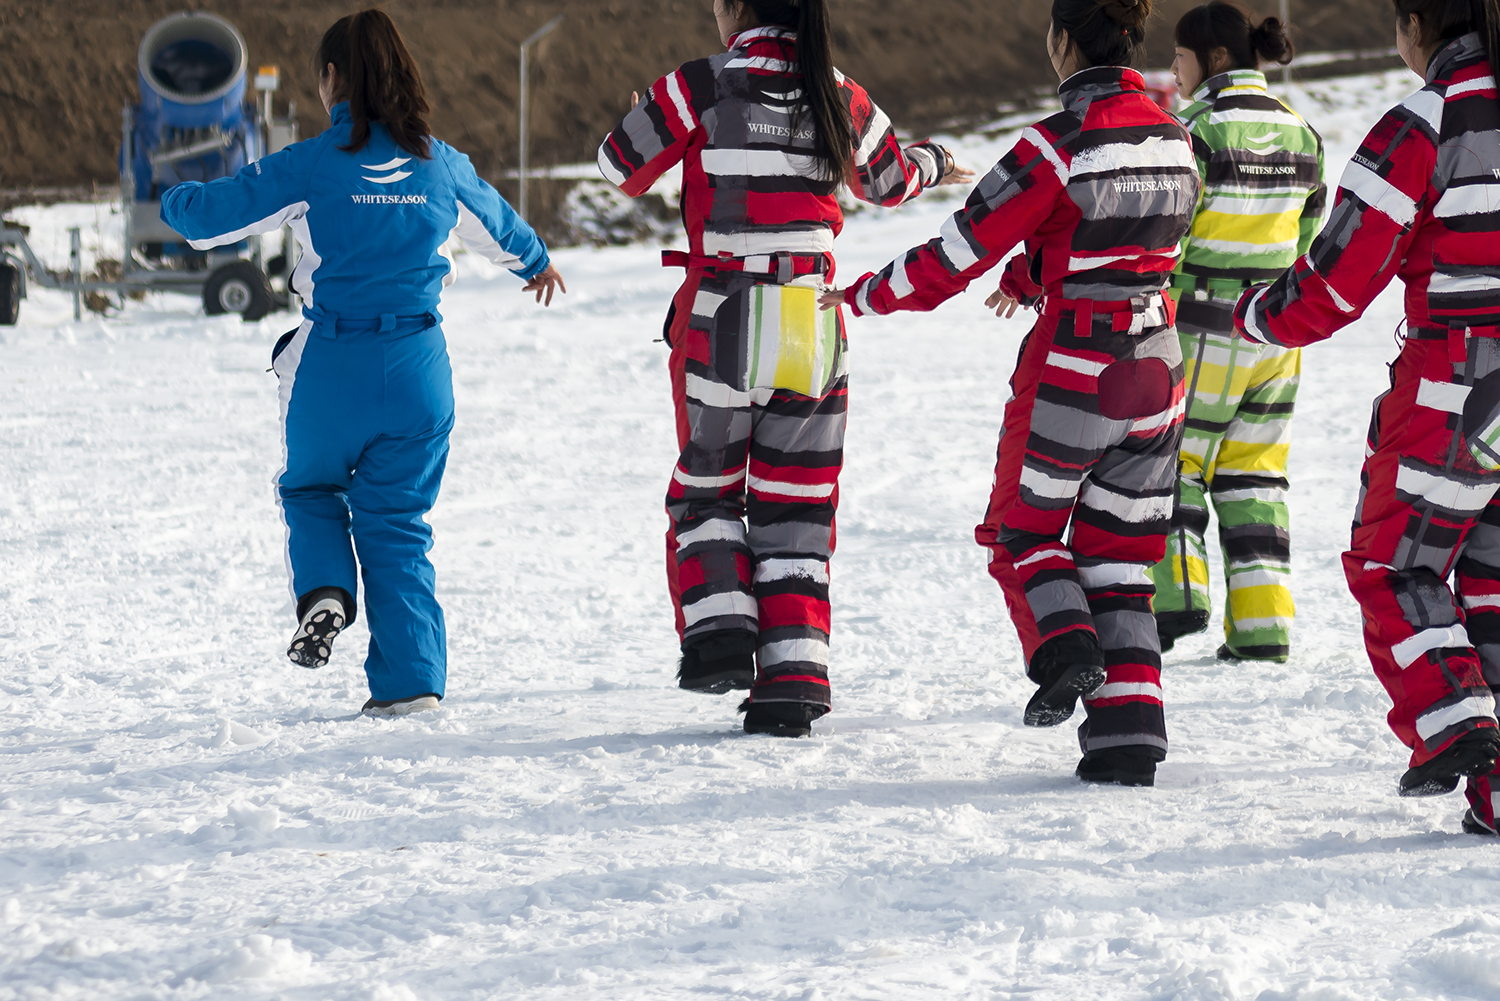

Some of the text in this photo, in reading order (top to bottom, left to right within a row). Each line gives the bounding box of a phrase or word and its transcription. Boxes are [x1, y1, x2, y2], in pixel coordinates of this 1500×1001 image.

[1238, 164, 1296, 175] WHITESEASON
[1113, 180, 1181, 193] WHITESEASON
[351, 194, 427, 205] WHITESEASON
